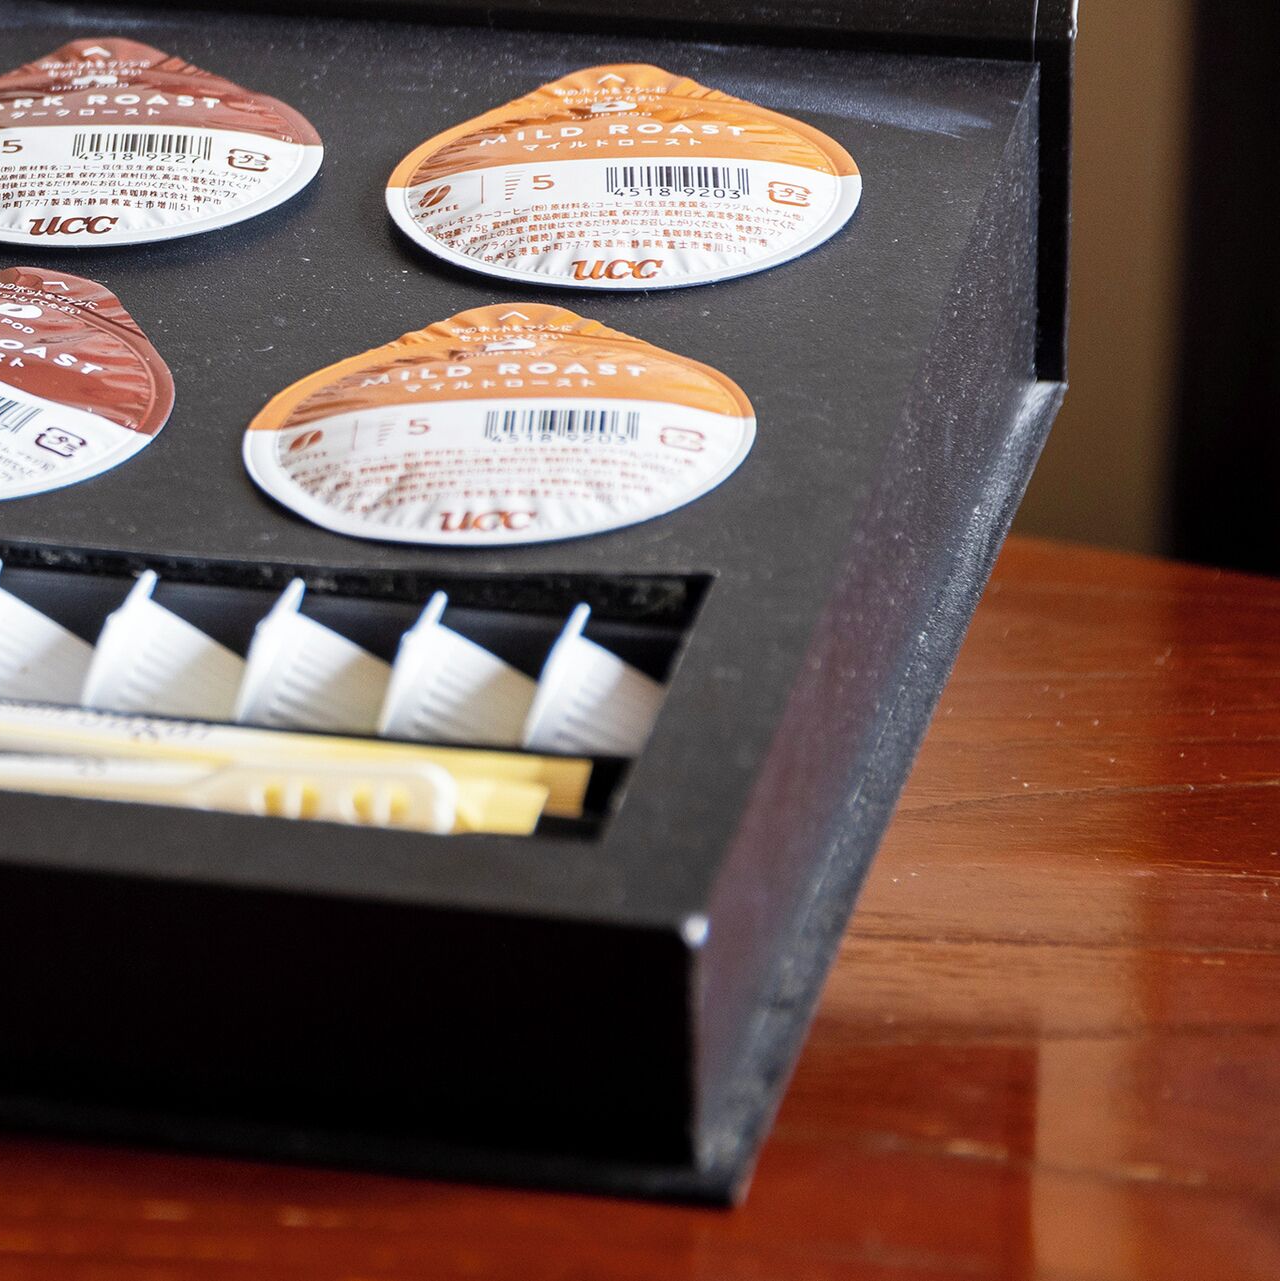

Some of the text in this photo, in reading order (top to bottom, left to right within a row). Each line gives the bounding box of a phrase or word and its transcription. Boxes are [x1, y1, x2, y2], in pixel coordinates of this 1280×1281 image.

[87, 93, 221, 110] ROAST
[10, 107, 162, 120] ダークロースト
[478, 123, 746, 148] MILD ROAST
[1, 138, 25, 155] 5
[522, 137, 703, 152] マイルドロースト
[77, 152, 202, 165] 4518 9227
[532, 173, 555, 191] 5
[613, 187, 742, 200] 4518 9203
[0, 318, 36, 335] POD
[361, 362, 648, 388] MILD ROAST
[403, 377, 598, 393] マイルドロースト
[407, 418, 432, 436] 5
